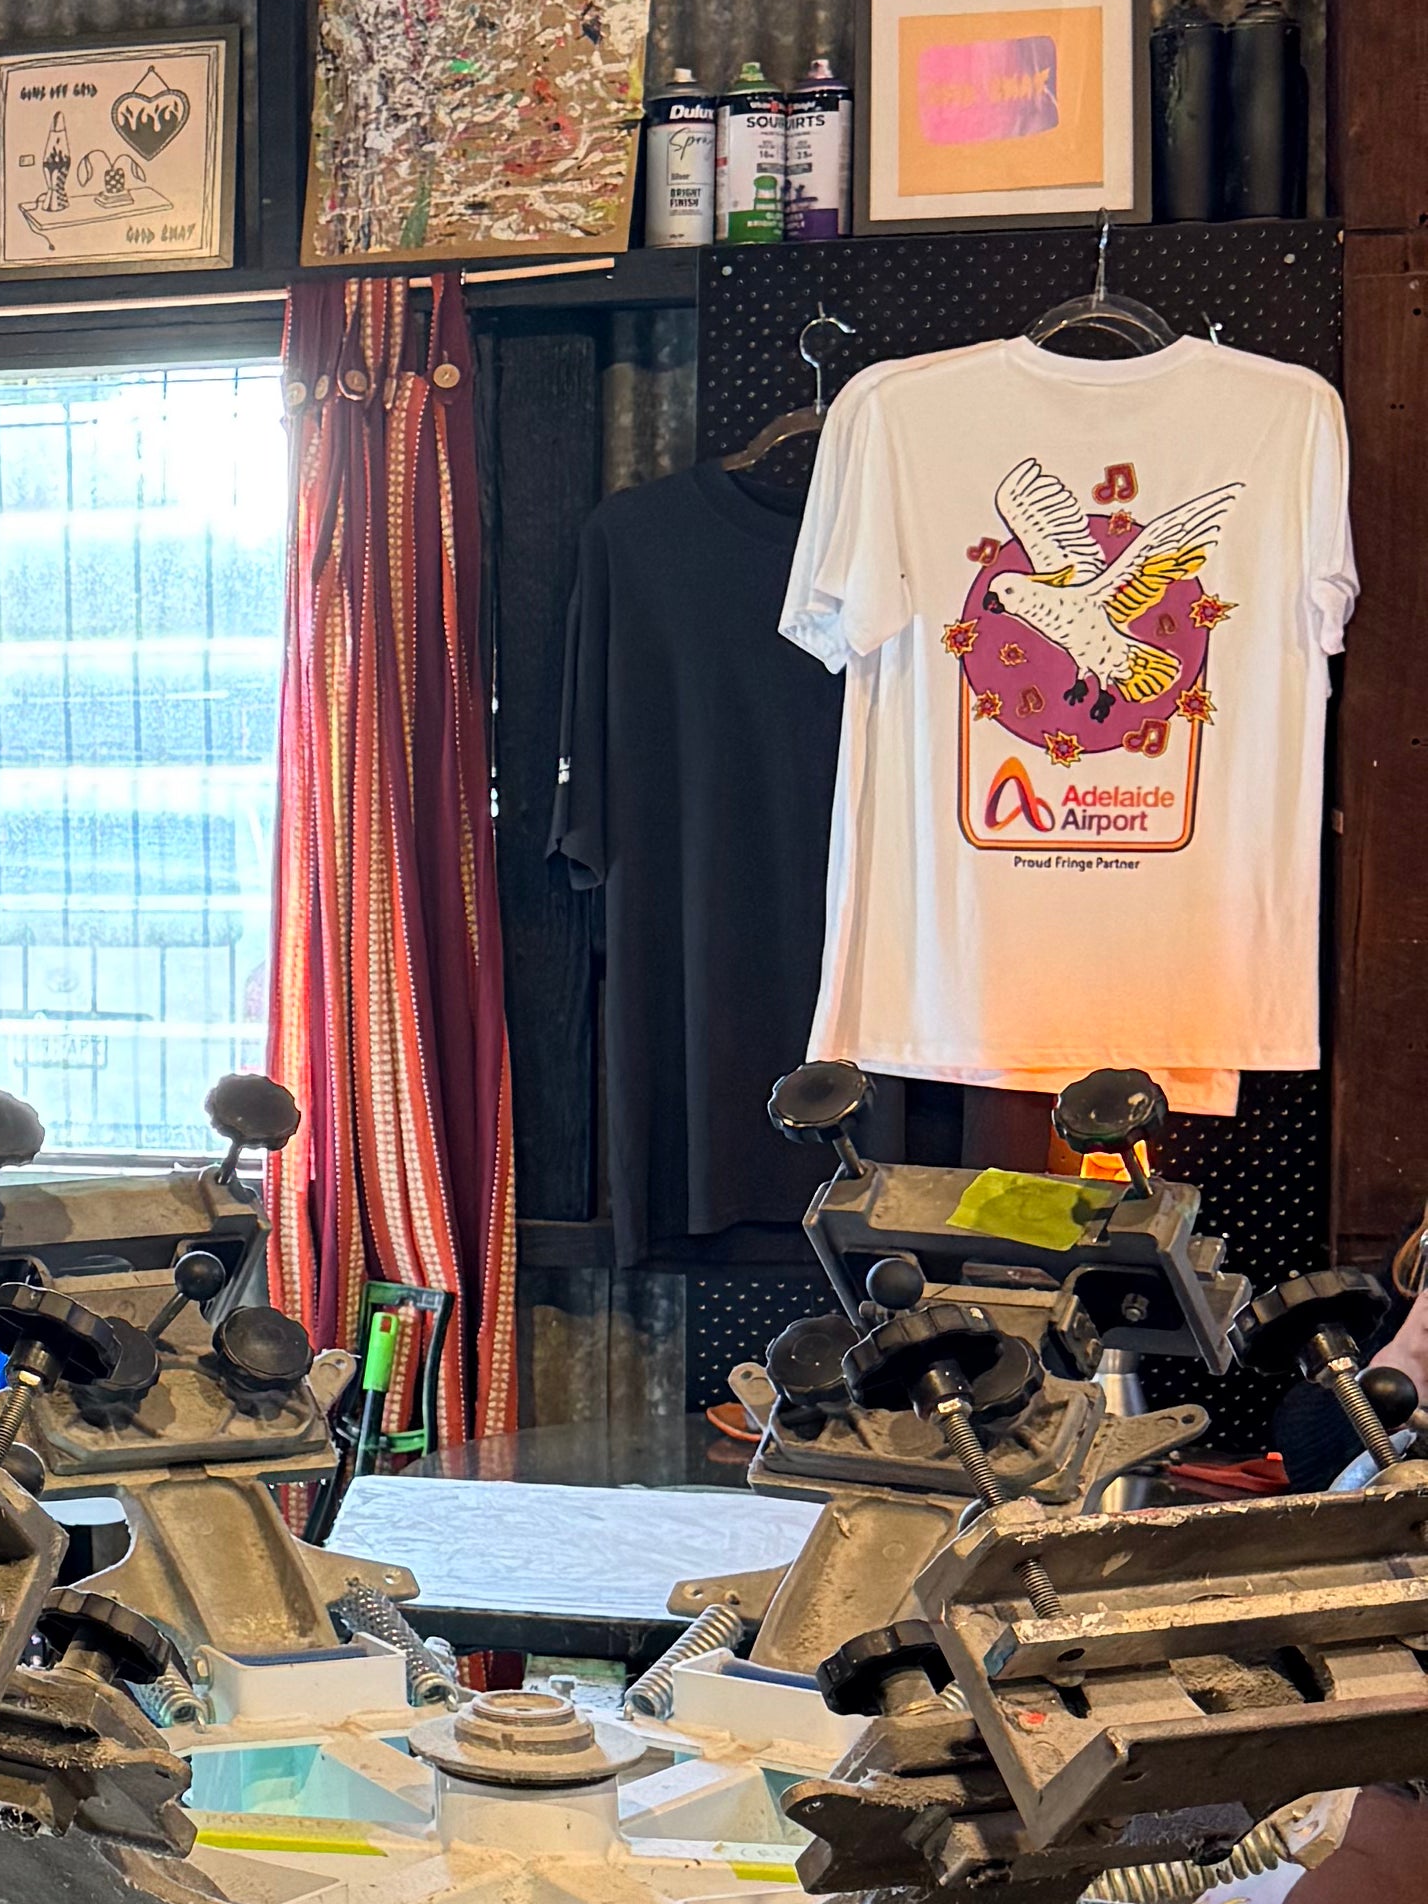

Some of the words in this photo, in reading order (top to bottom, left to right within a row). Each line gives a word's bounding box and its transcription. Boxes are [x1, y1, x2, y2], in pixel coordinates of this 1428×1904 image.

[1061, 785, 1175, 808] Adelaide
[1061, 808, 1148, 835] Airport
[1014, 856, 1051, 869] Proud
[1055, 856, 1093, 872] Fringe
[1096, 857, 1140, 870] Partner
